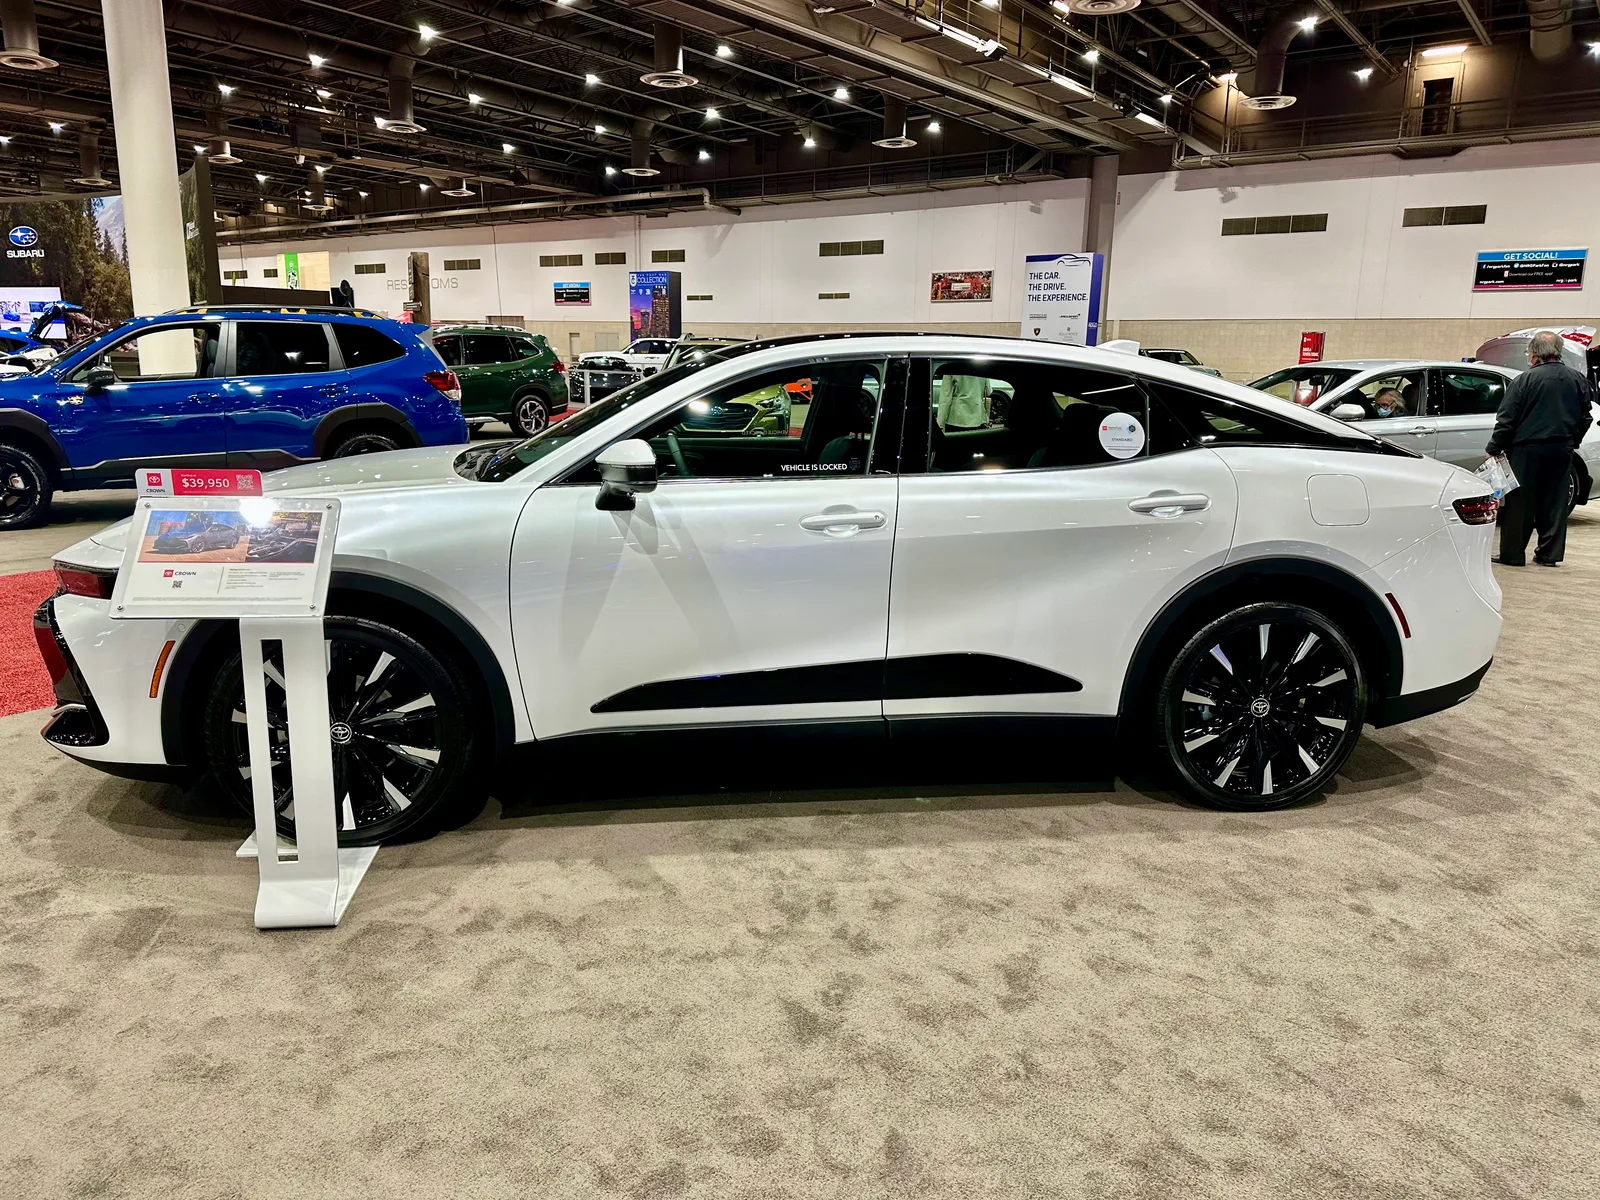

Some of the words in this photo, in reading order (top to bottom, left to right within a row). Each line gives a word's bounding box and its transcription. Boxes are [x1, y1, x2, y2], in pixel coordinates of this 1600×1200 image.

[6, 249, 45, 258] SUBARU
[1522, 252, 1558, 260] SOCIAL!
[387, 278, 459, 290] RESOMS
[1028, 294, 1041, 302] THE
[1042, 293, 1088, 301] EXPERIENCE.
[819, 463, 848, 471] LOCKED
[182, 478, 230, 489] $39,950
